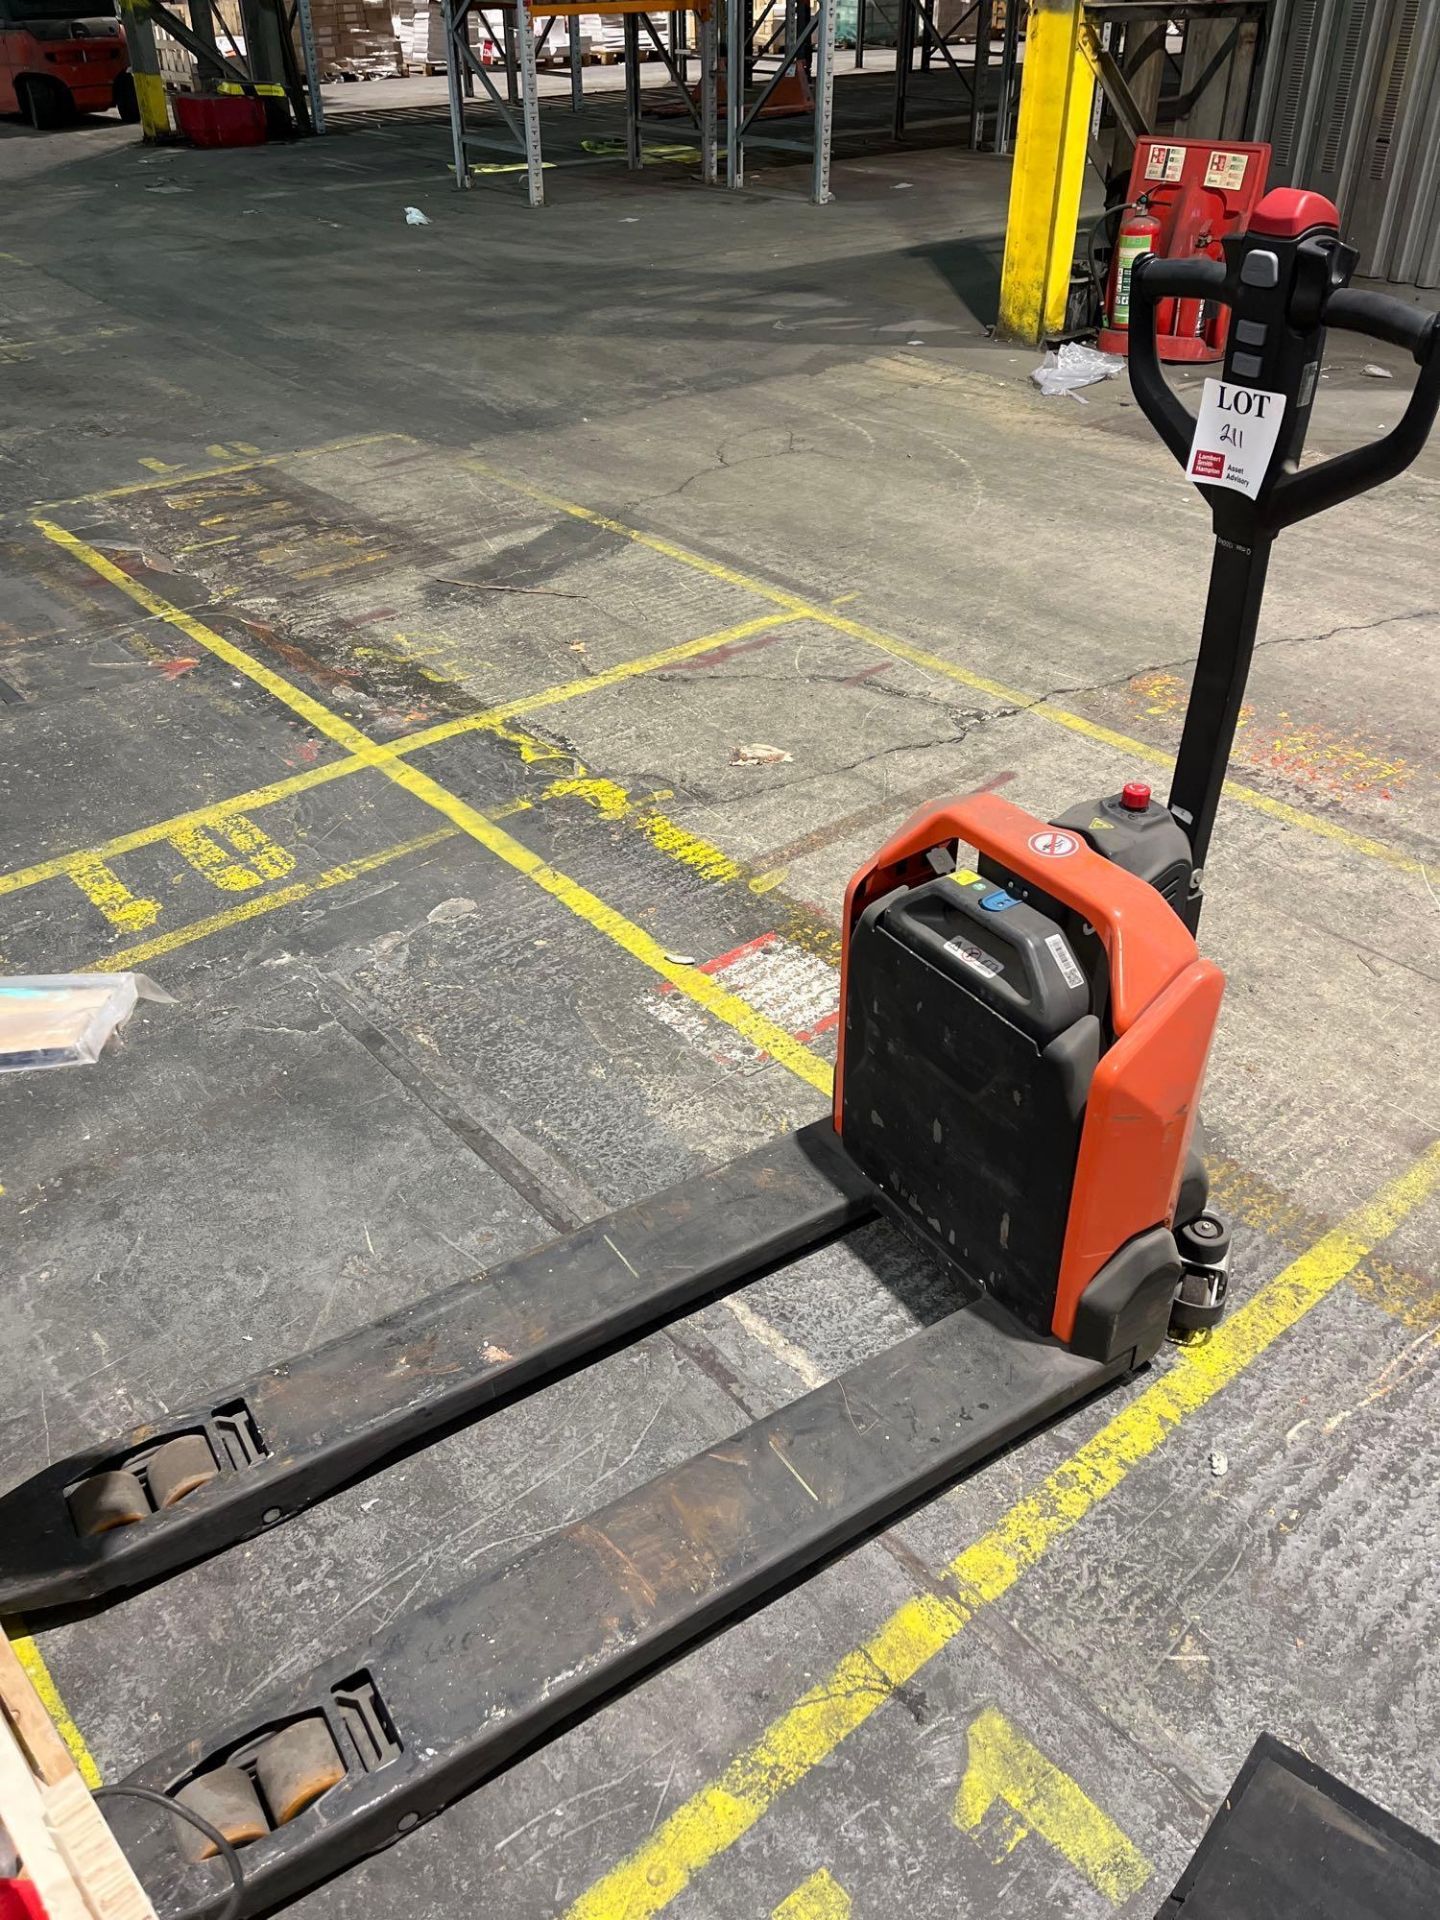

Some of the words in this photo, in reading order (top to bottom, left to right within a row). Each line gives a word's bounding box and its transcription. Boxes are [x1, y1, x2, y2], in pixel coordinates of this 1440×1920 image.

[1217, 385, 1271, 418] LOT
[1219, 423, 1243, 448] 211
[1198, 452, 1222, 463] Lambert
[1196, 459, 1214, 468] Smith
[1195, 465, 1221, 475] Hampton
[1227, 464, 1244, 475] Asset
[1226, 473, 1250, 488] Advisory
